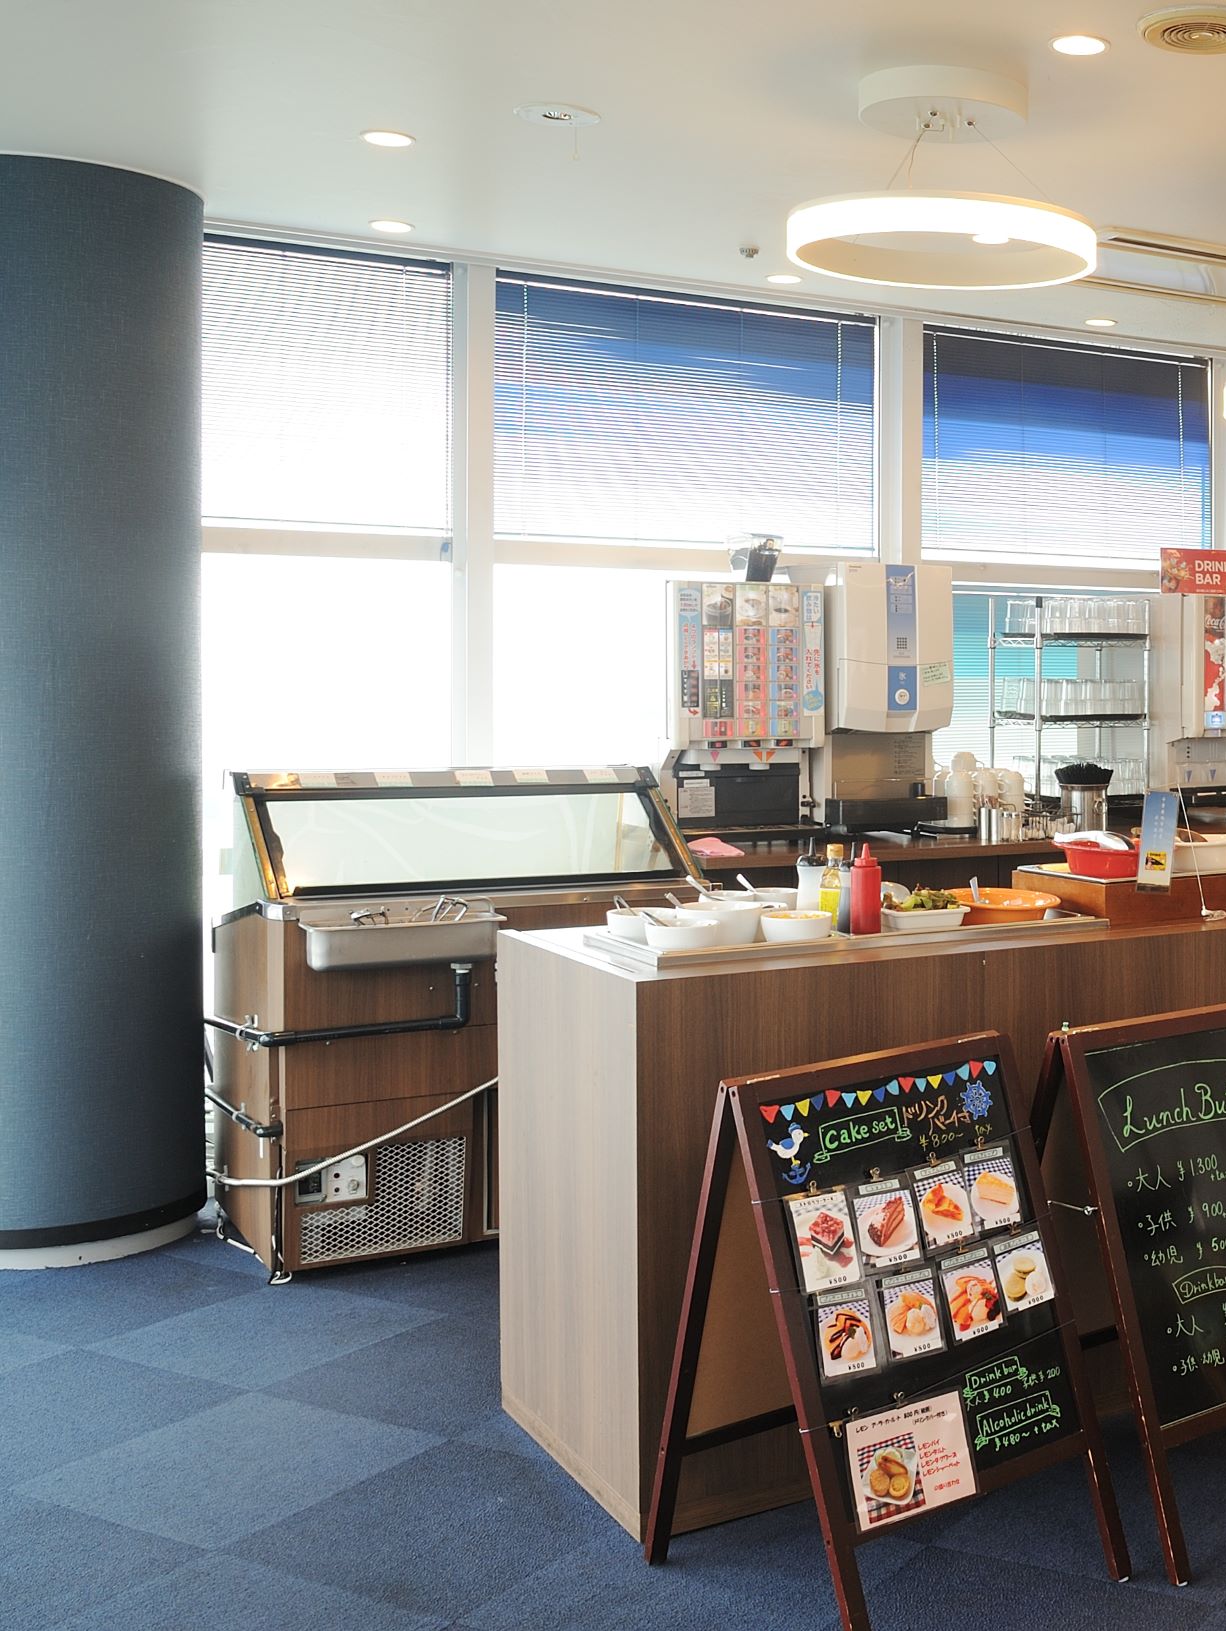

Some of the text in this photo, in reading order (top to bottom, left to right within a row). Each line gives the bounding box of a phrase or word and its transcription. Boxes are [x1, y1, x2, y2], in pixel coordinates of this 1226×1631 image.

[1196, 573, 1221, 585] BAR
[902, 1095, 948, 1127] ドリンク
[1123, 1088, 1196, 1137] Lunch
[825, 1115, 896, 1149] Cake set
[1136, 1164, 1172, 1193] 大人
[1145, 1209, 1177, 1237] 子供
[1151, 1245, 1183, 1267] 幼児
[1175, 1313, 1204, 1338] 大人
[971, 1363, 1018, 1389] Drink bar
[982, 1397, 1050, 1436] Alcoholic drink
